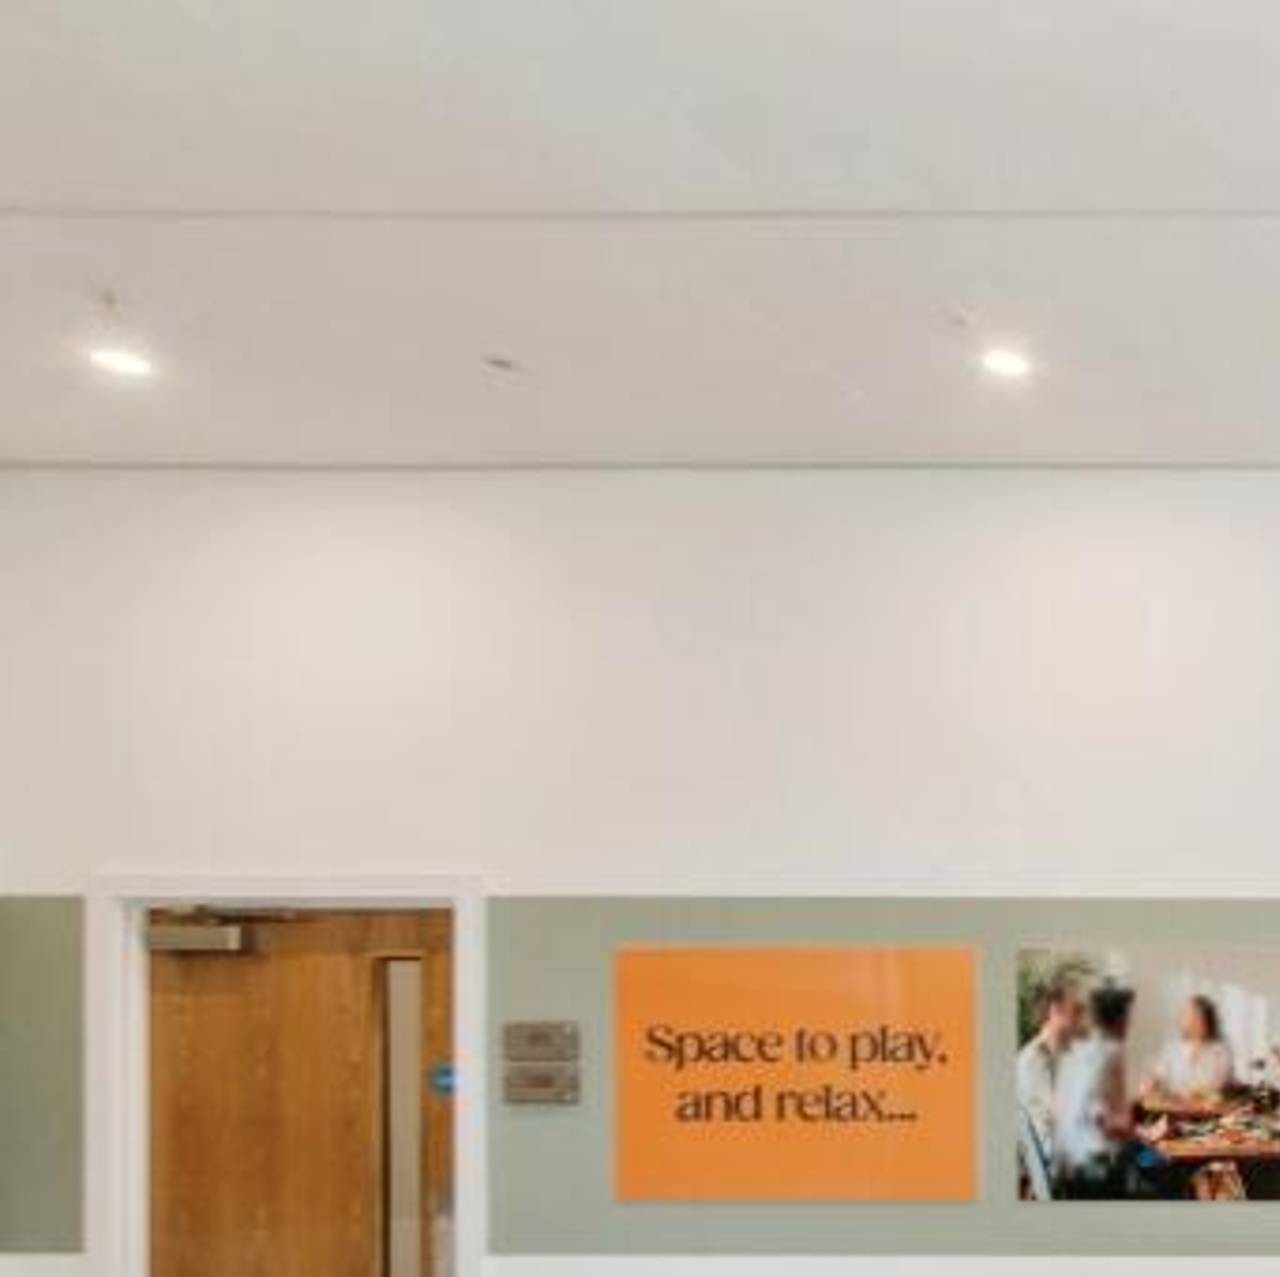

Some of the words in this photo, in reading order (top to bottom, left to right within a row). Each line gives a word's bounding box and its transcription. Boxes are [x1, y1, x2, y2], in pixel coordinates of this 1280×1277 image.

[644, 1022, 783, 1071] Space
[795, 1027, 838, 1063] to
[675, 1084, 763, 1121] and
